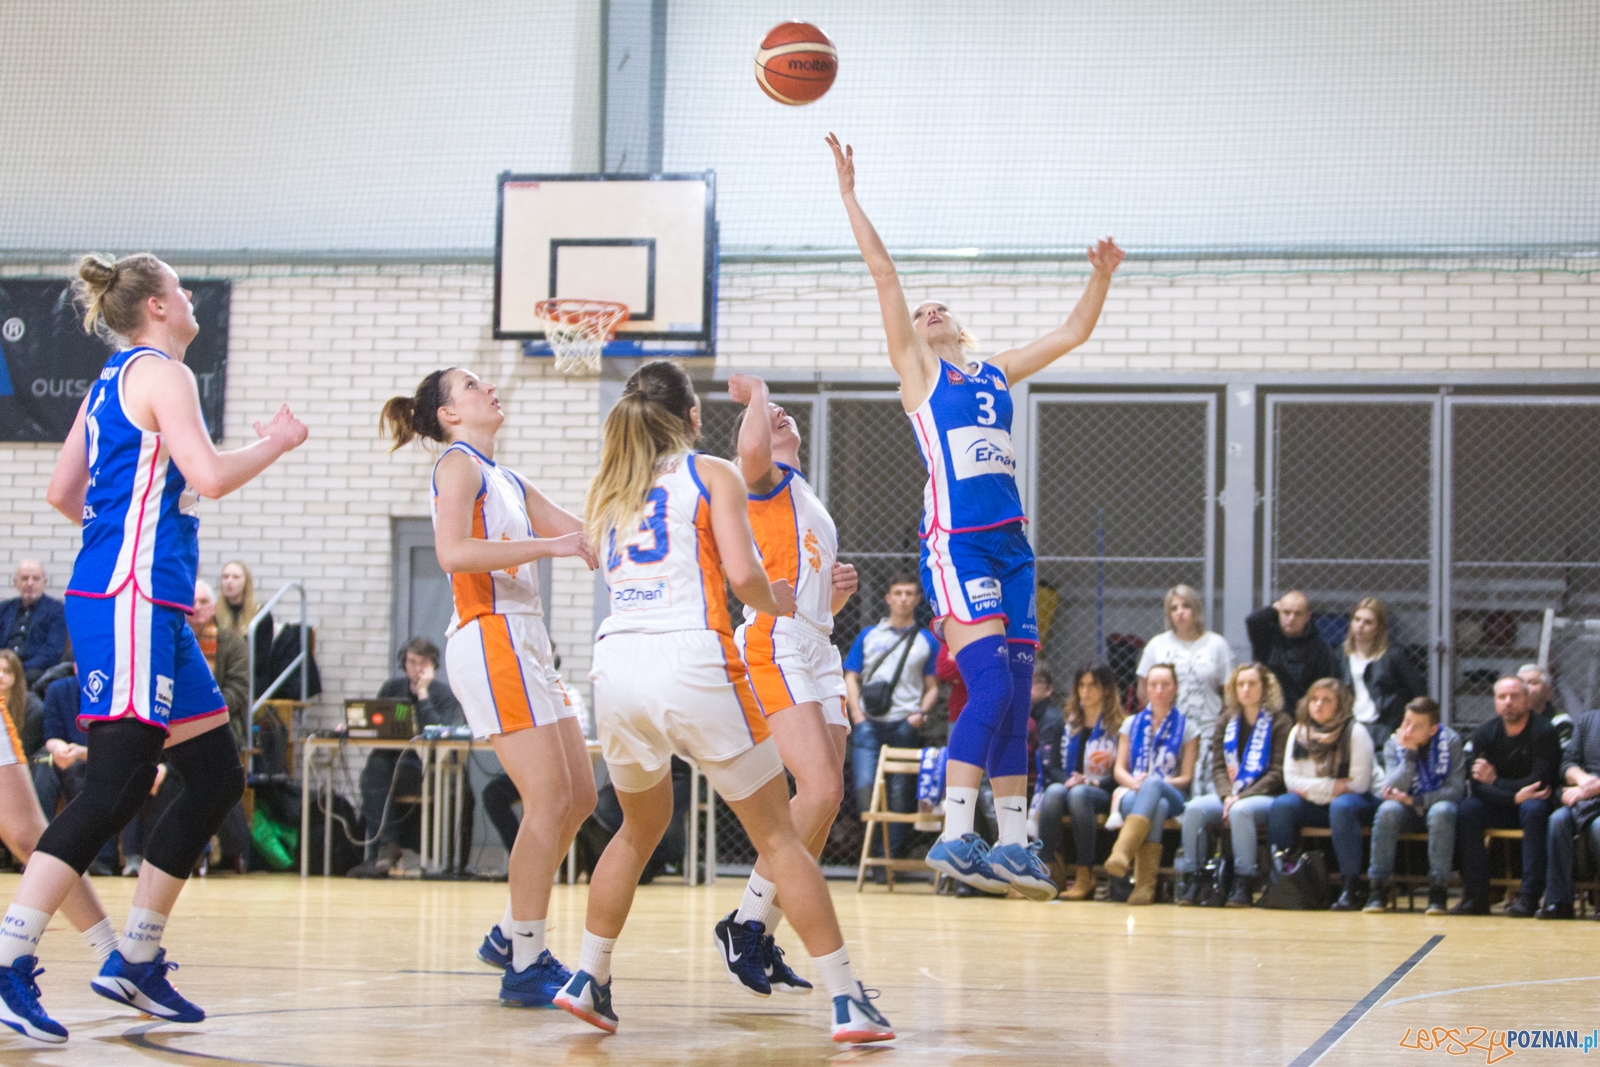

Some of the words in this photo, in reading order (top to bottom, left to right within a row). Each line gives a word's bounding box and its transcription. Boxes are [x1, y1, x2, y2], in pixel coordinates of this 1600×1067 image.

[787, 58, 834, 72] molten
[975, 391, 997, 426] 3
[607, 484, 671, 574] 13
